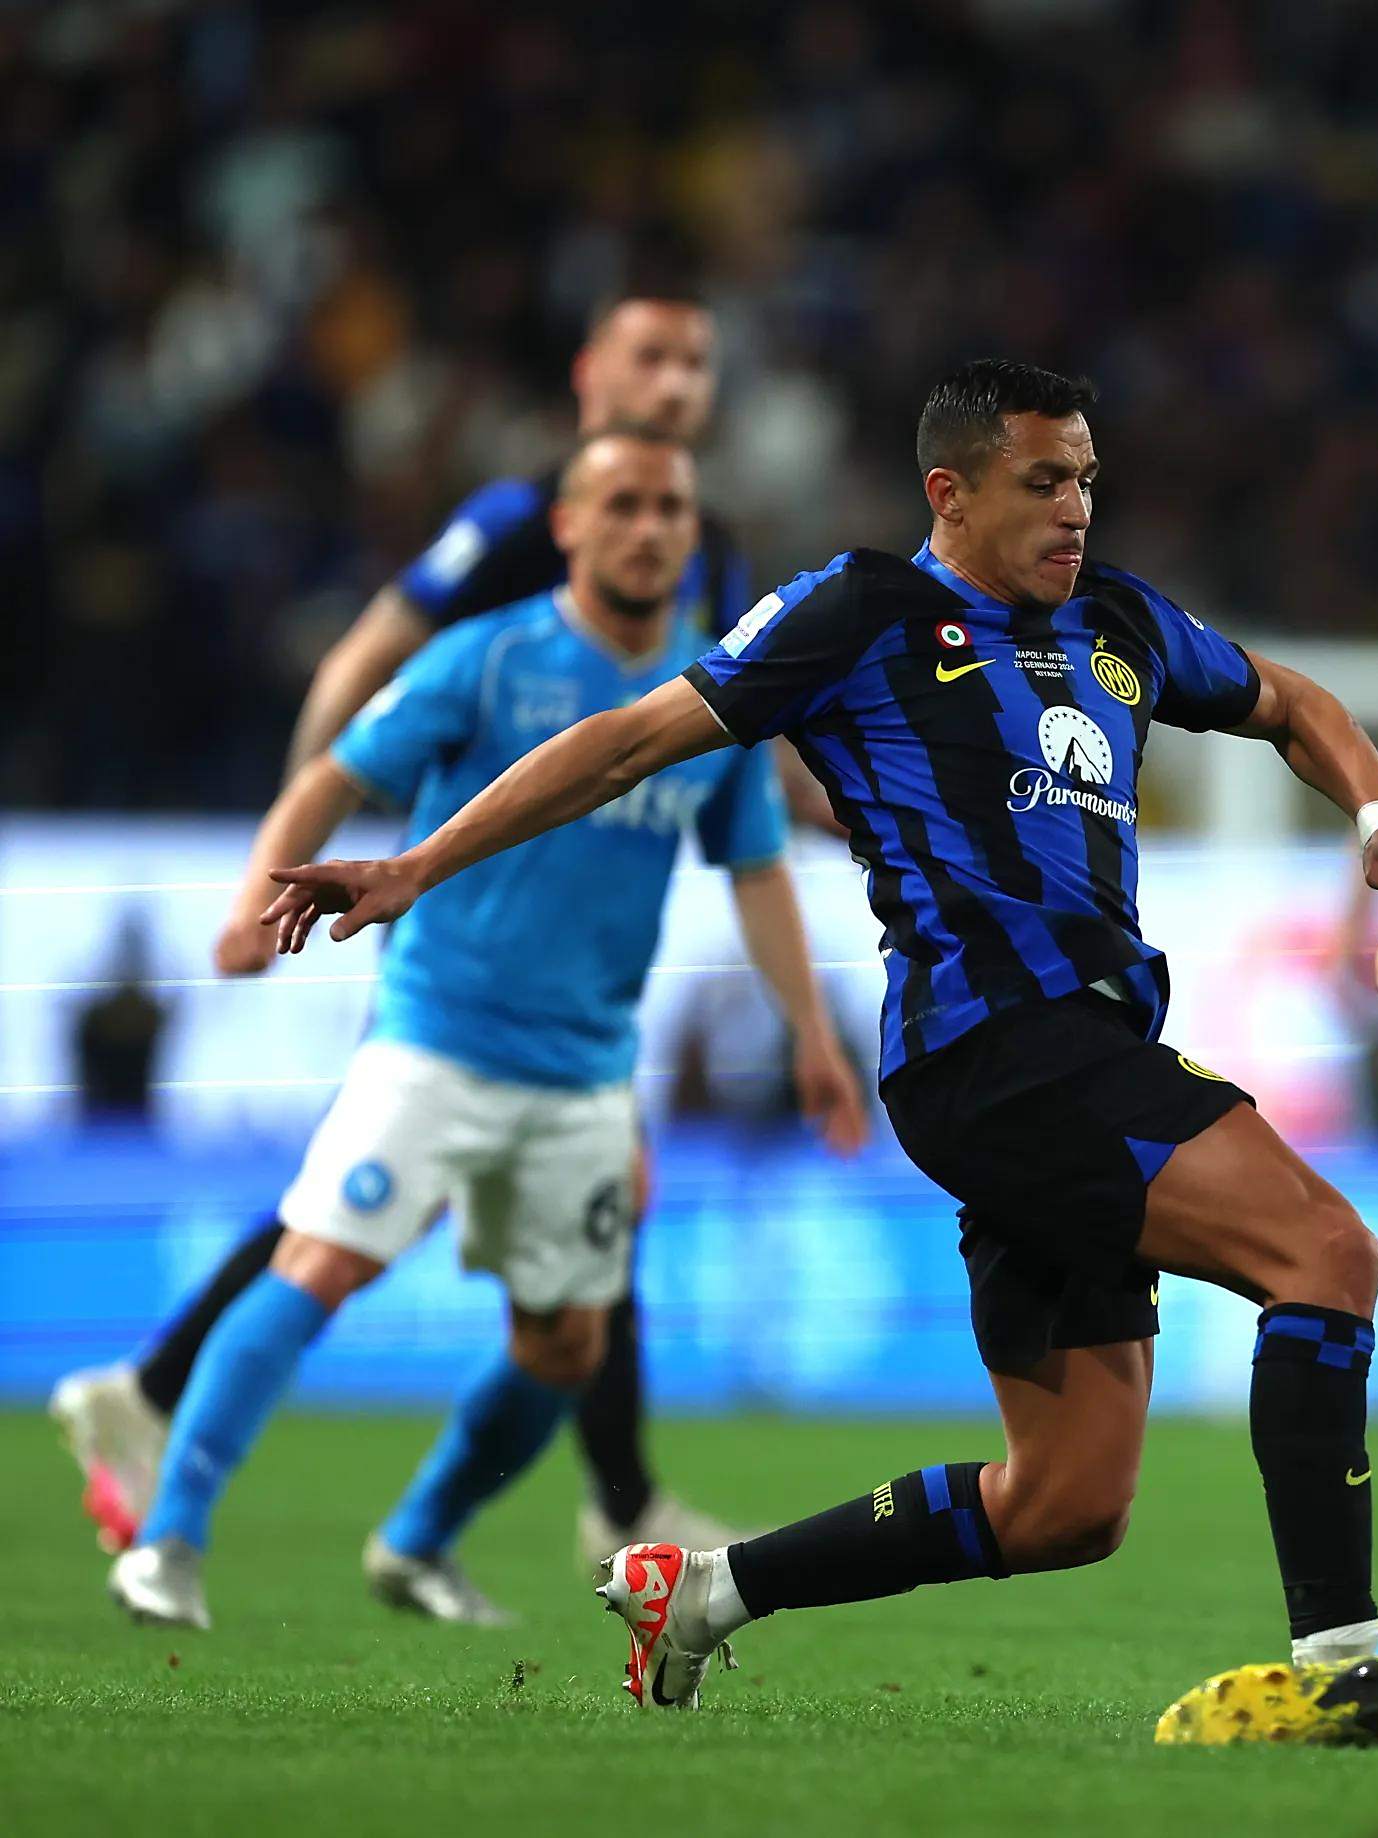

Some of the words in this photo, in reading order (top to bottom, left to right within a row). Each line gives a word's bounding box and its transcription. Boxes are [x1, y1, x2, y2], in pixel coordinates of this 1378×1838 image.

[1015, 650, 1042, 660] NAPOLI
[1047, 652, 1069, 662] INTER
[1013, 660, 1024, 668] 22
[1024, 661, 1058, 670] GENNAIO
[1058, 663, 1075, 671] 2024
[1034, 670, 1063, 678] RIYADH
